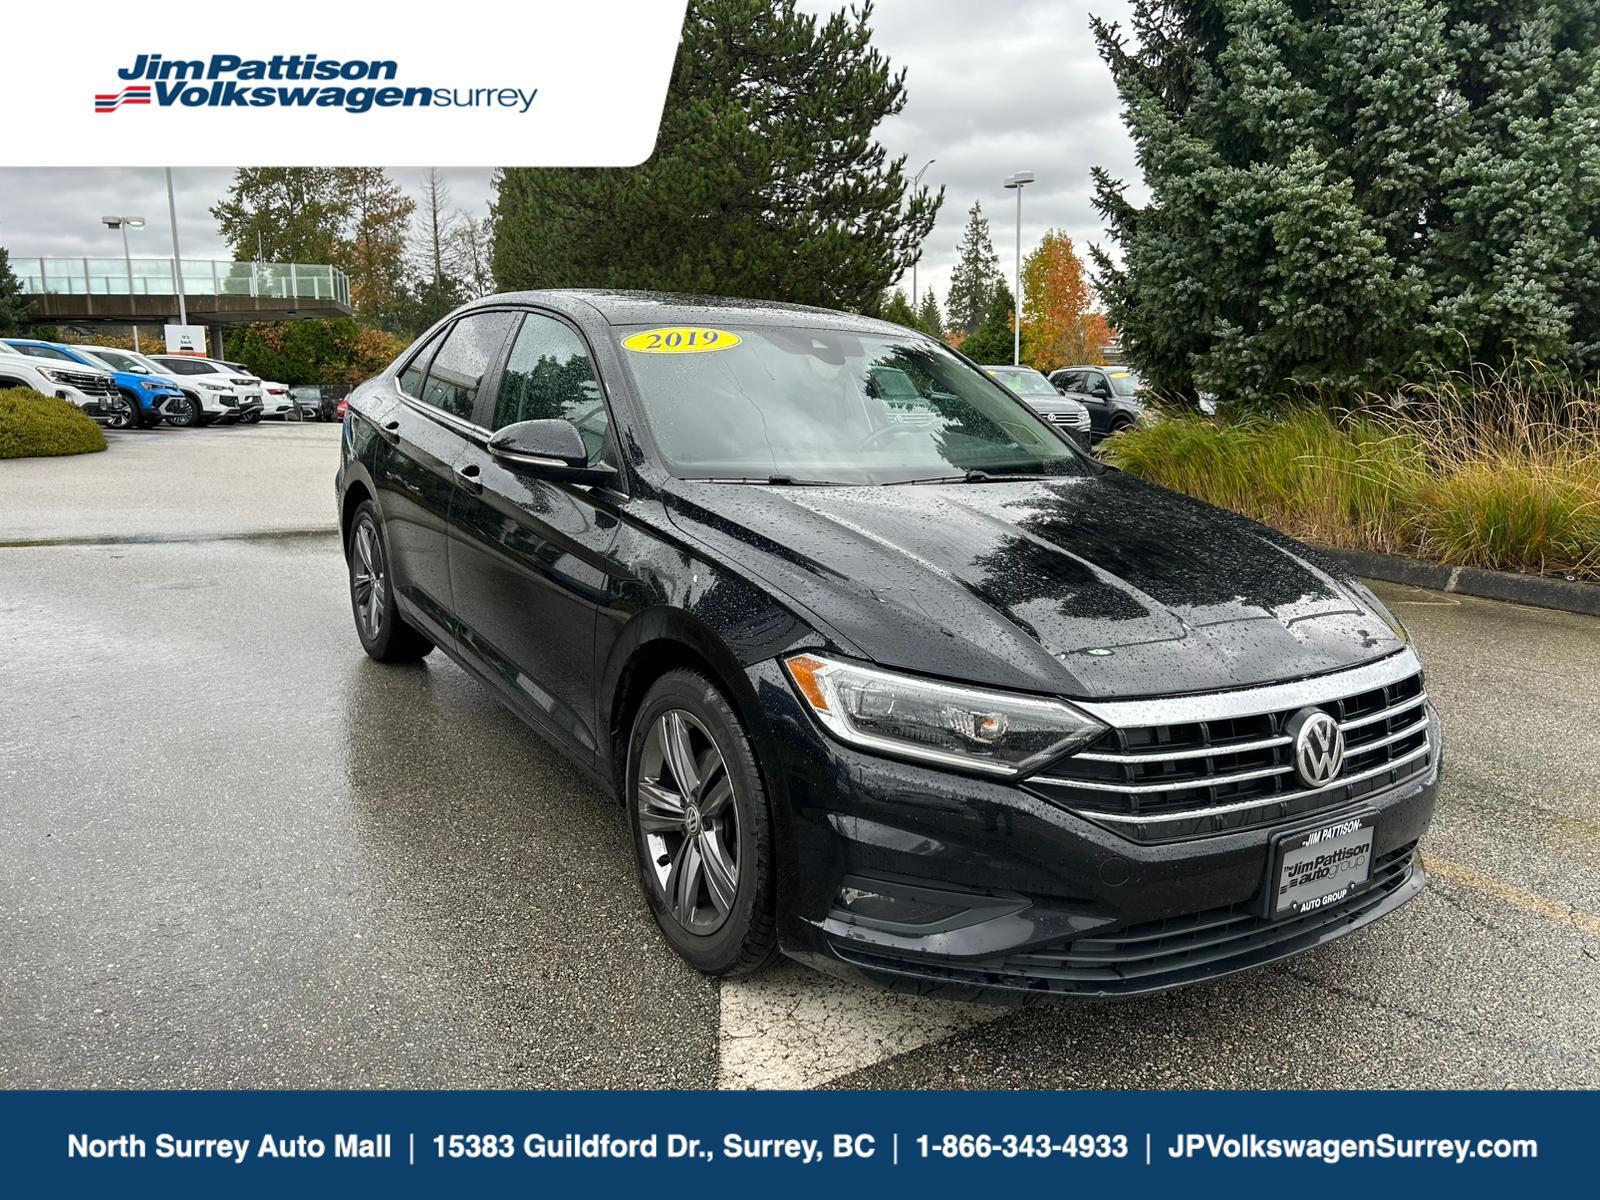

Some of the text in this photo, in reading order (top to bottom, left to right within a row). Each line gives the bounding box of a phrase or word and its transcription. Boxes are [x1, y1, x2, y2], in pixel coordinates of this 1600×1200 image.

[646, 331, 718, 349] 2019
[1305, 819, 1361, 847] JIM PATTISON
[1288, 861, 1314, 878] Jim
[1314, 842, 1370, 869] Pattison
[1300, 889, 1348, 913] AUTO GROUP
